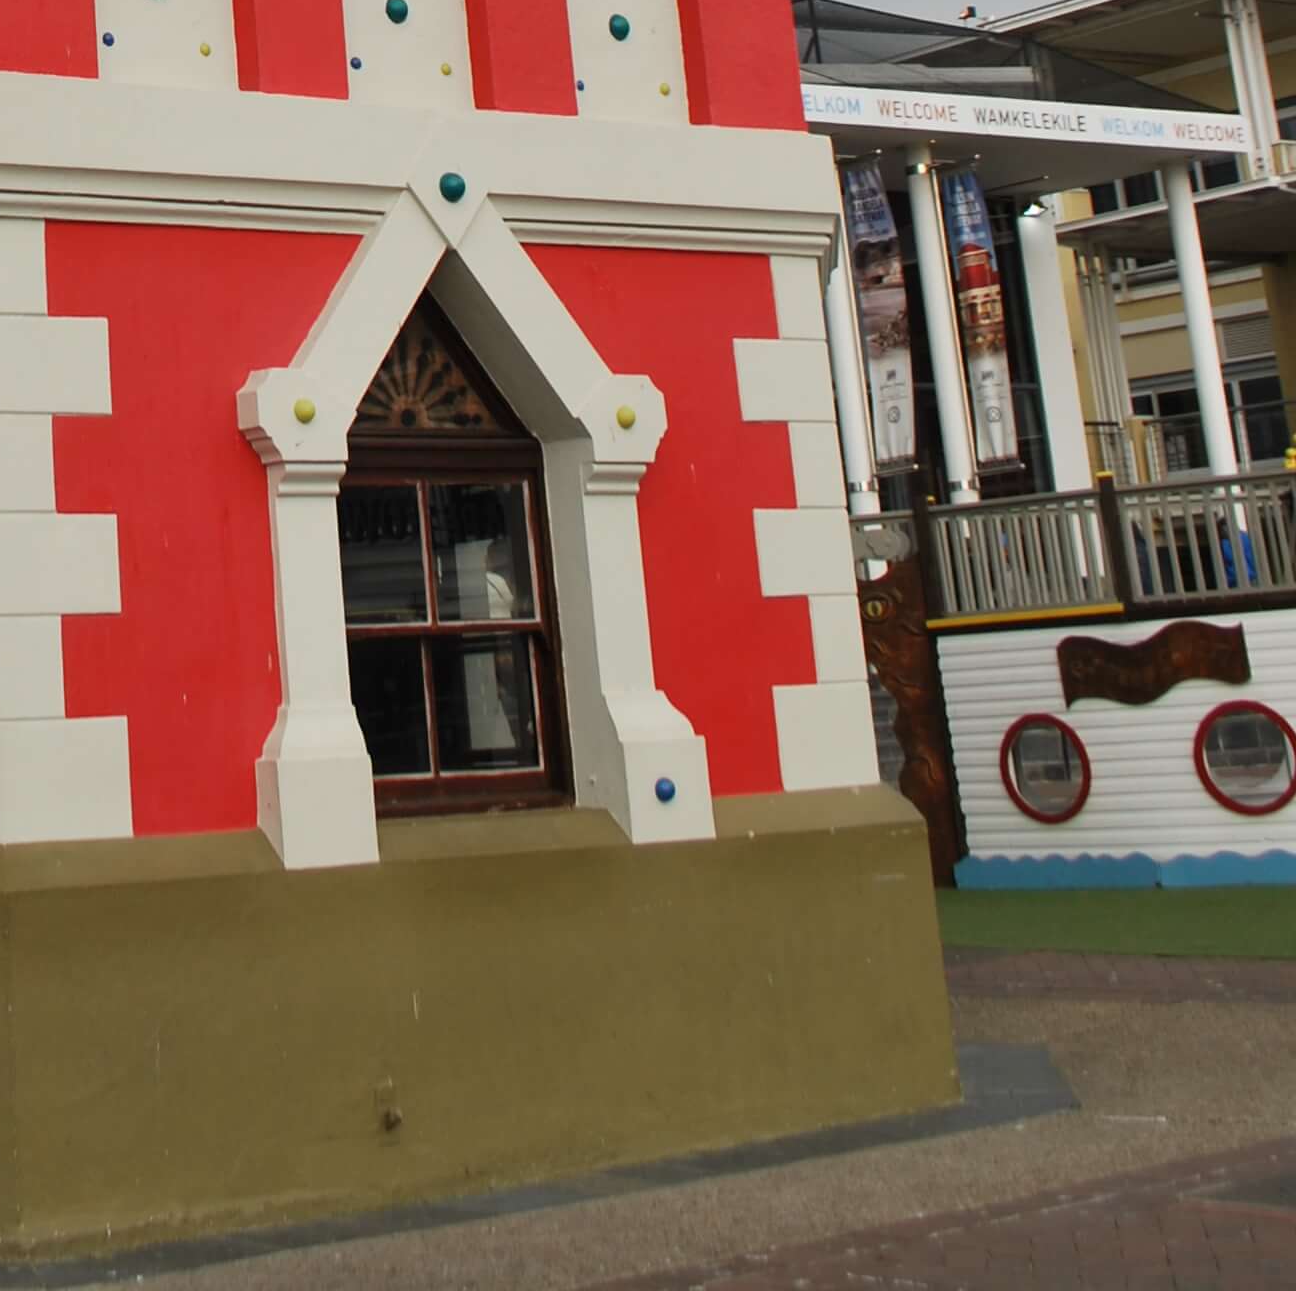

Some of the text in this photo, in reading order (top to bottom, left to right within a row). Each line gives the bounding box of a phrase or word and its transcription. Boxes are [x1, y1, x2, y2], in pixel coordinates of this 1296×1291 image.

[803, 93, 1247, 144] ELKOM WELCOME WAMKELEKILE WELKOM WELCOME
